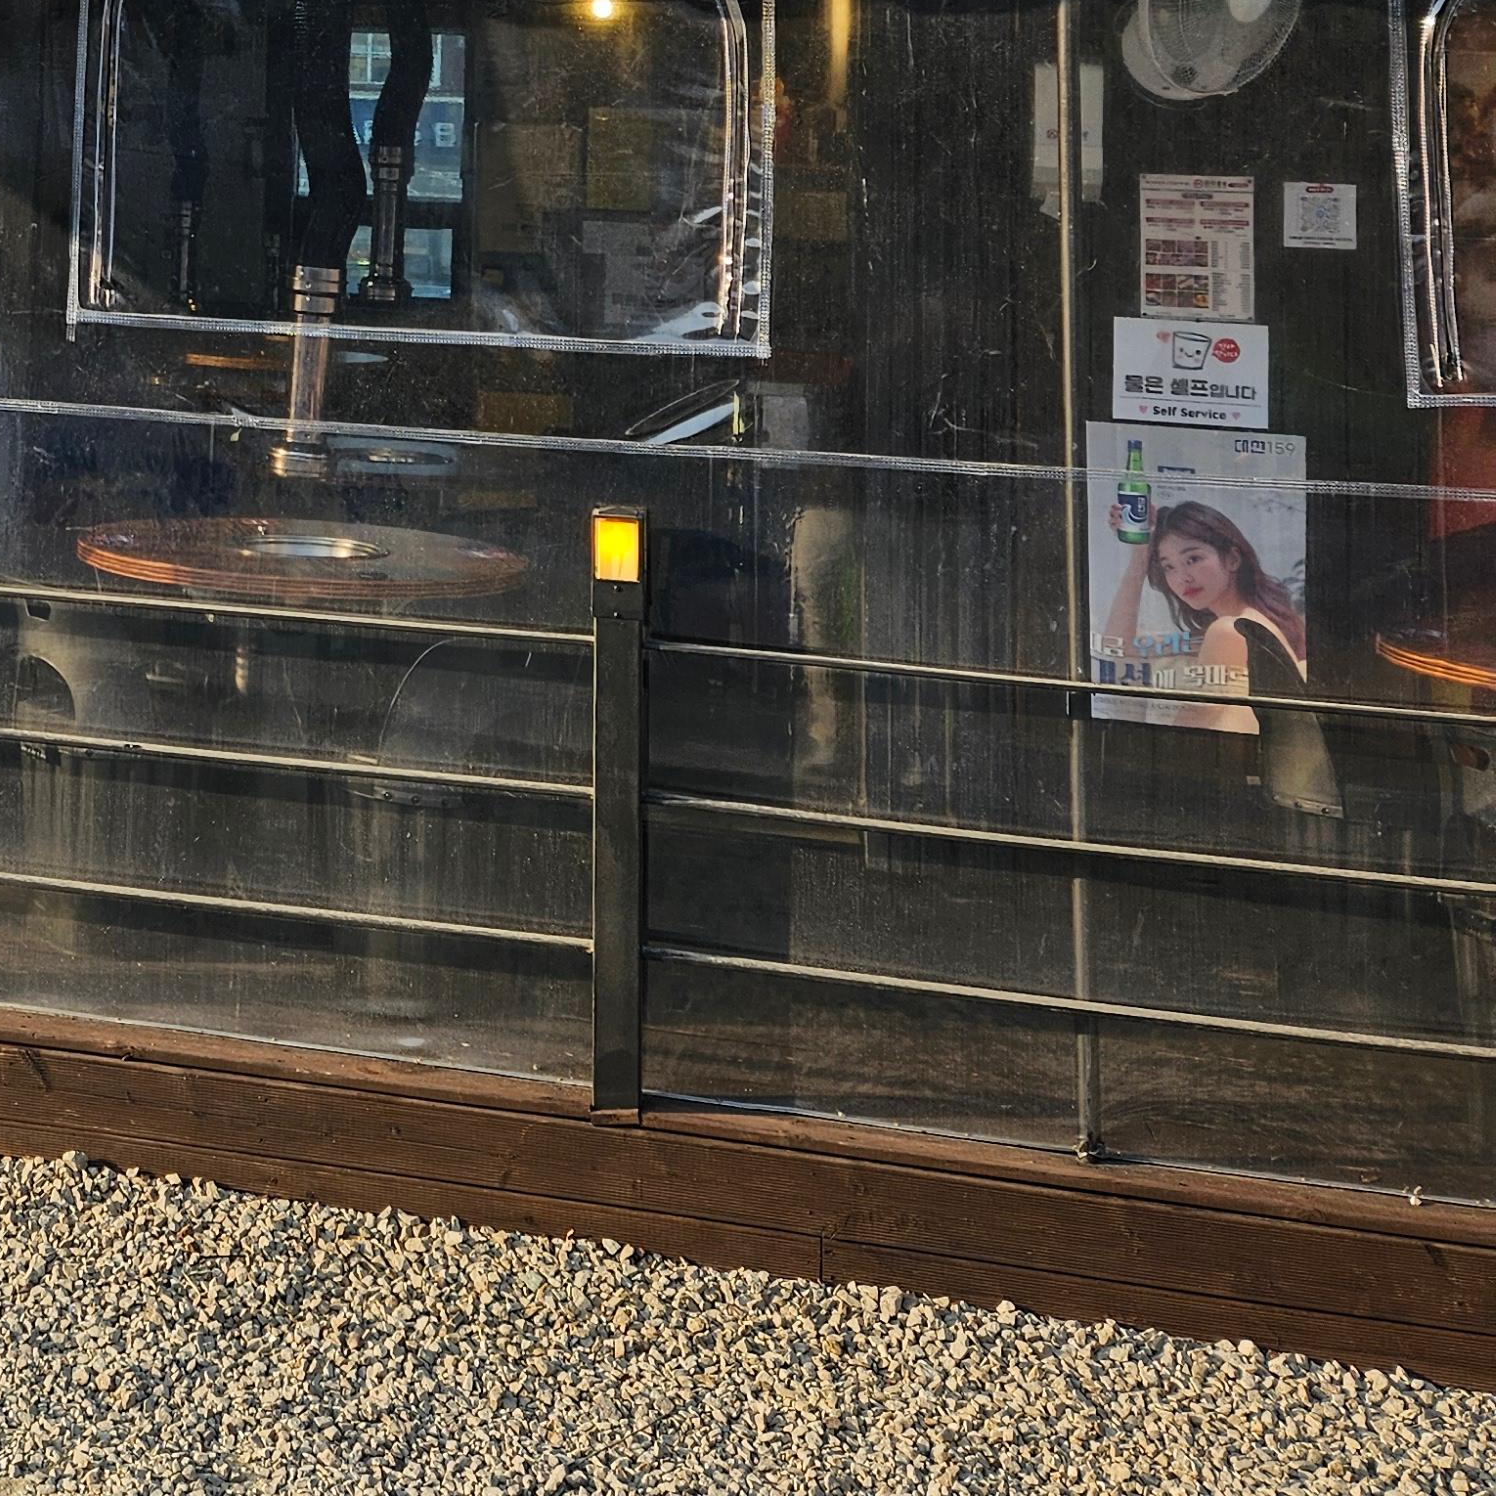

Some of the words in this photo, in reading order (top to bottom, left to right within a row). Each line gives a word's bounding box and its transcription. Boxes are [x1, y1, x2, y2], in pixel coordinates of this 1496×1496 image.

[1171, 377, 1257, 401] 셀프입니다
[1152, 405, 1178, 416] Self
[1180, 407, 1228, 420] Service
